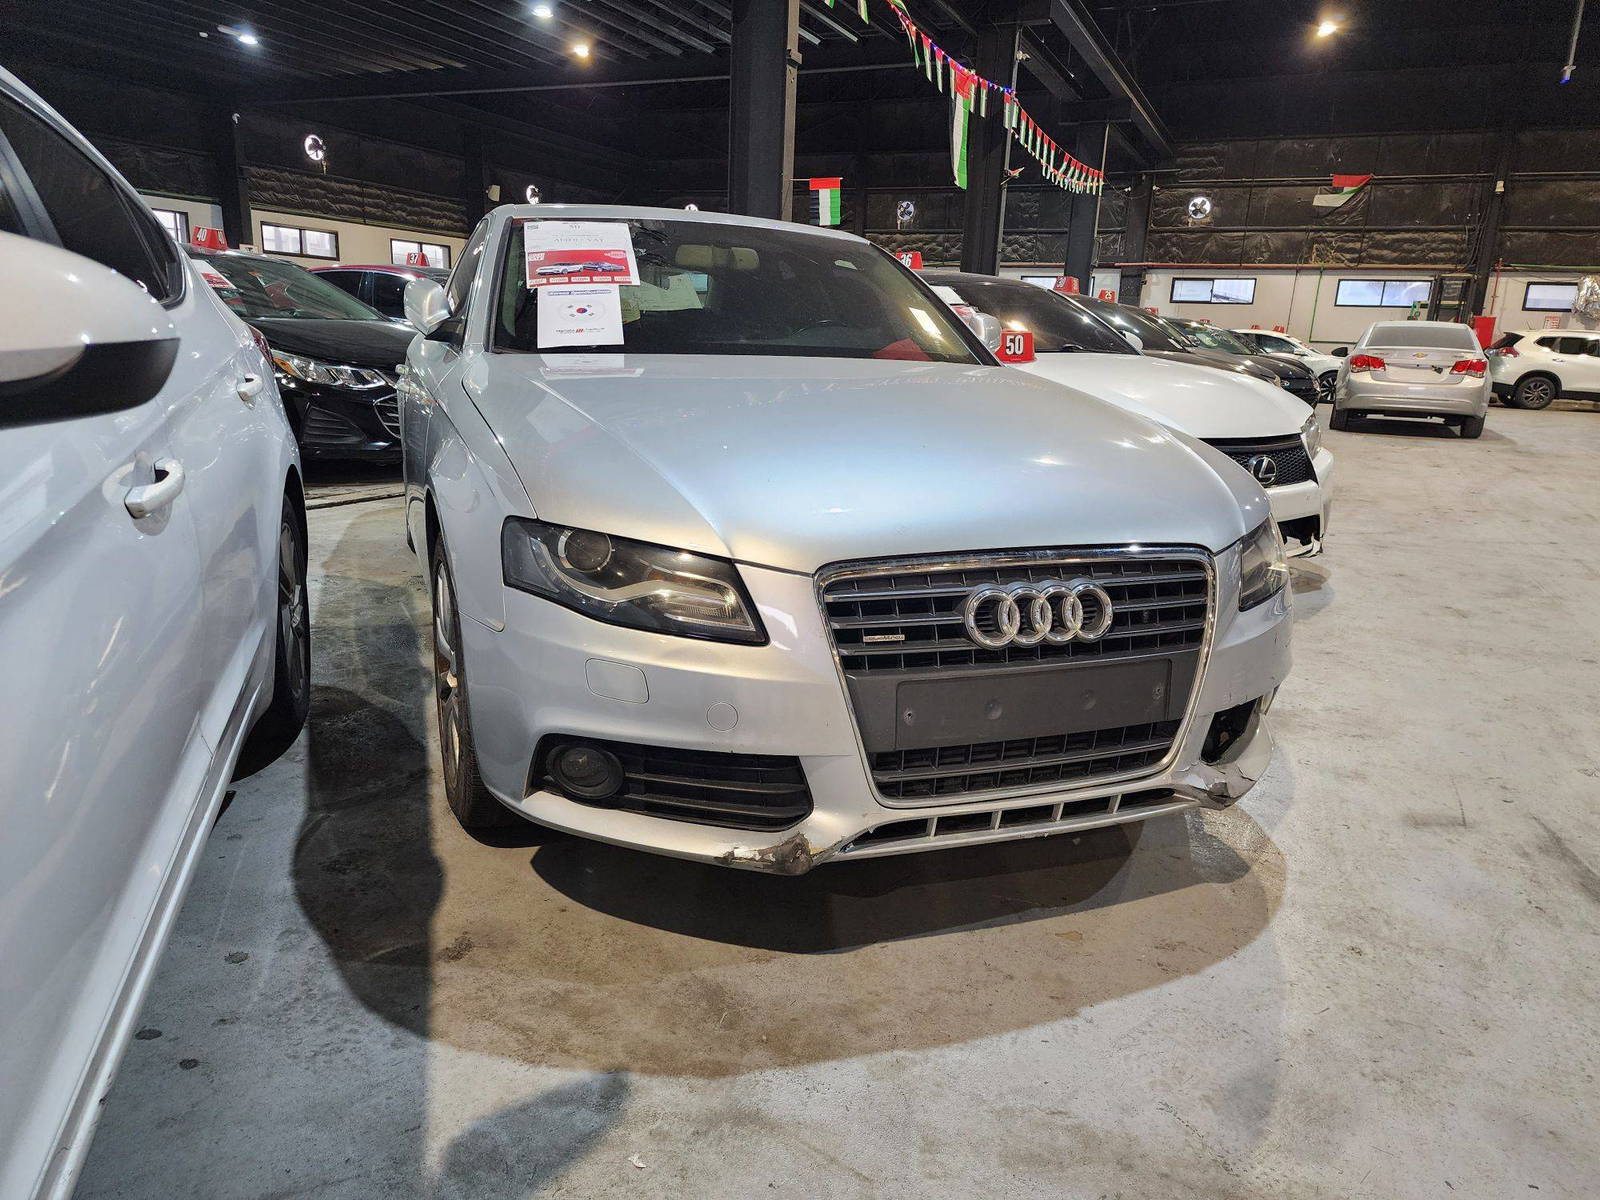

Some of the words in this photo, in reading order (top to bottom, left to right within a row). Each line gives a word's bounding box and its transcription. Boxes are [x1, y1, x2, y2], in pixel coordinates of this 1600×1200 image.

[196, 228, 207, 242] 40
[409, 253, 419, 264] 37
[1006, 335, 1024, 355] 50
